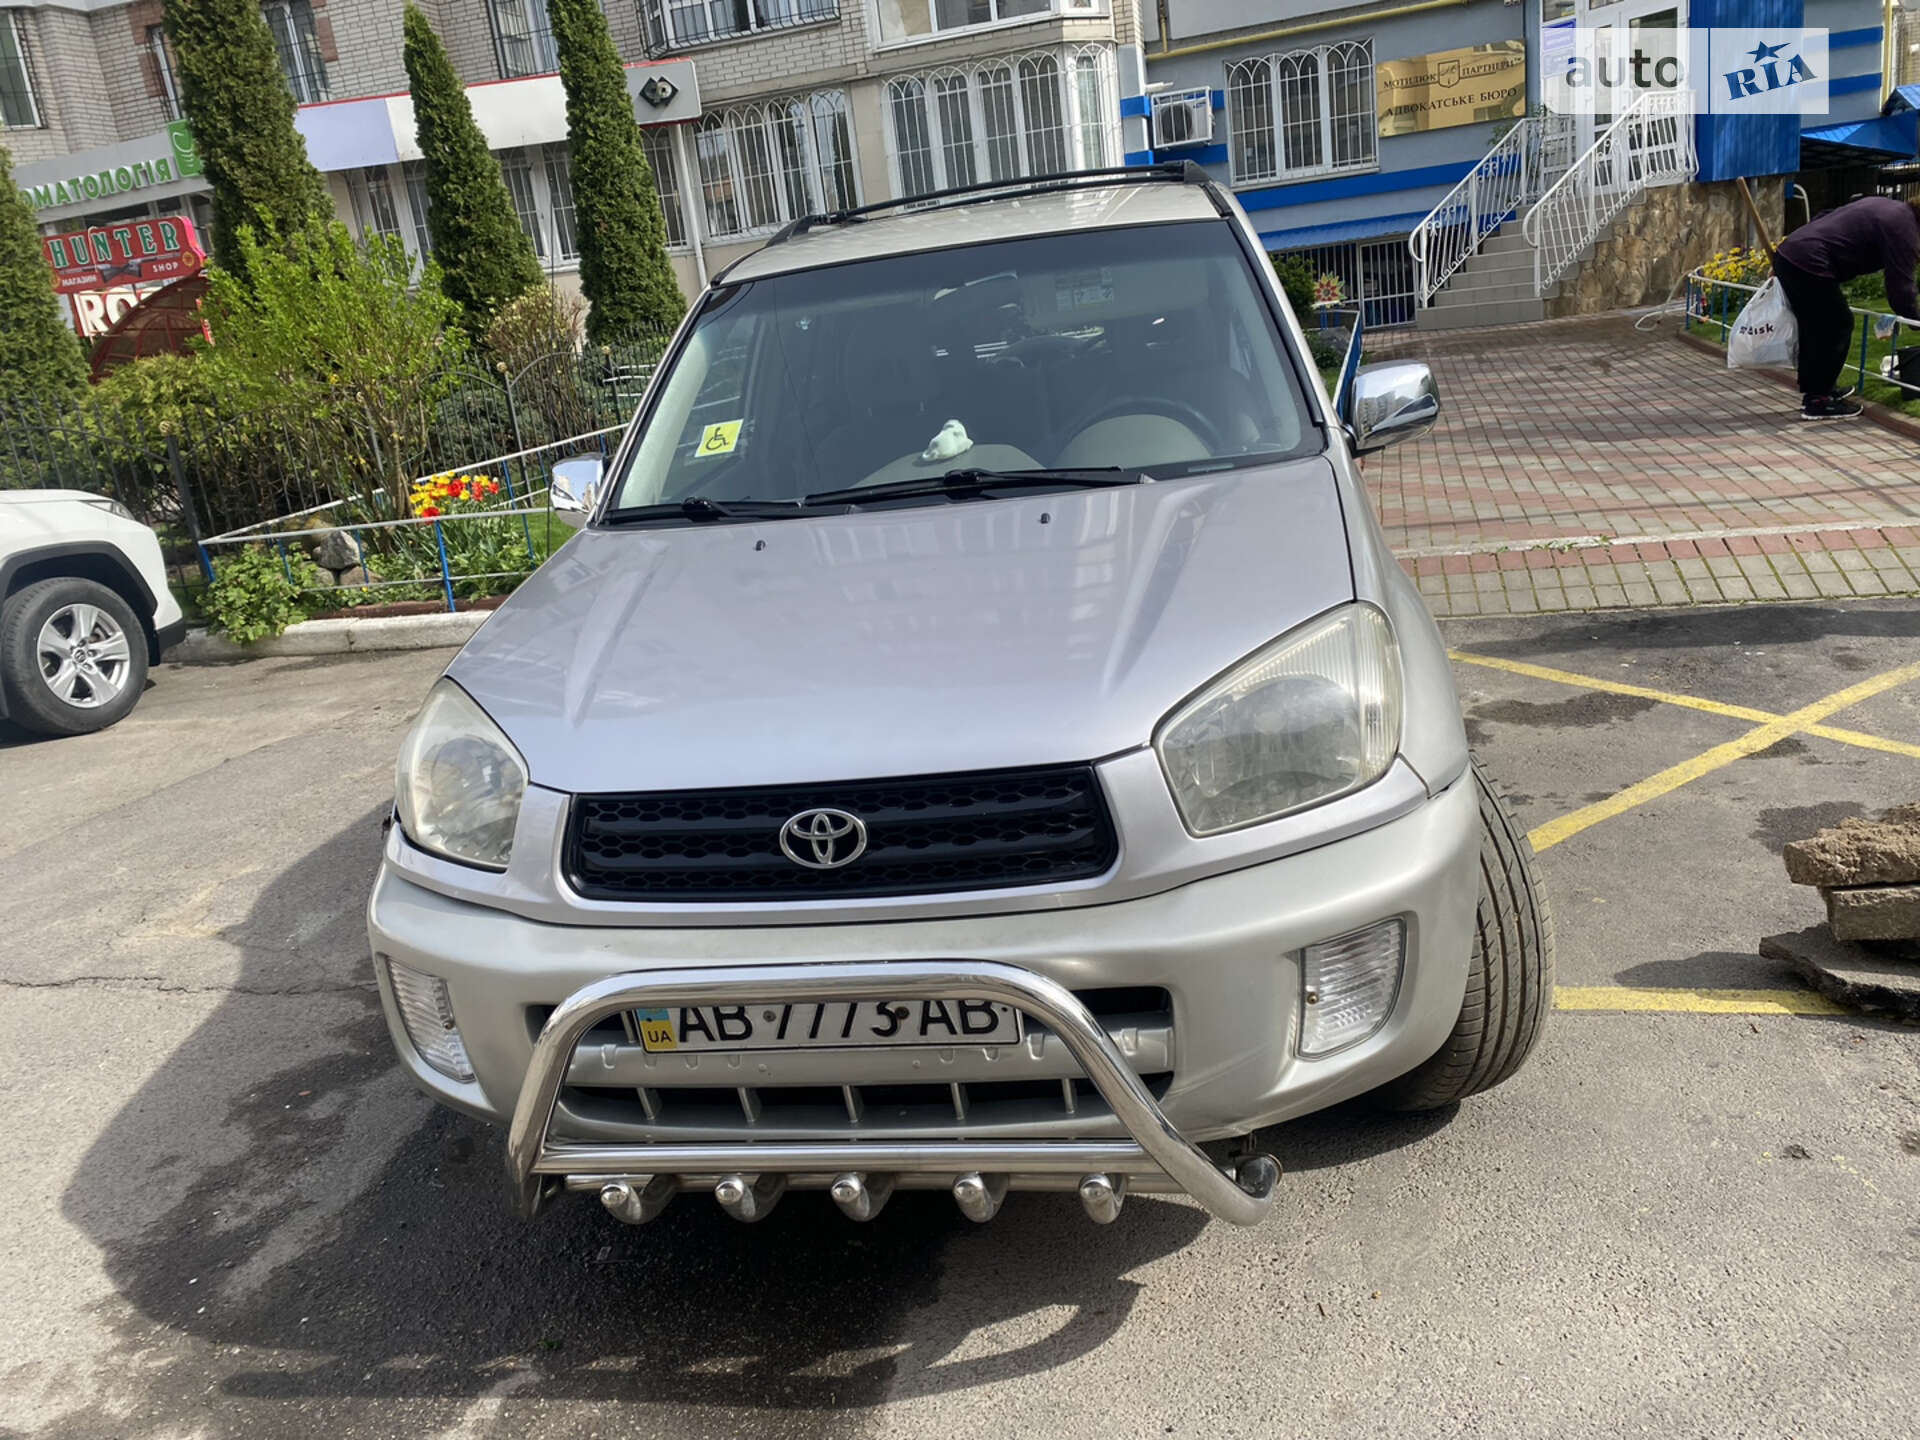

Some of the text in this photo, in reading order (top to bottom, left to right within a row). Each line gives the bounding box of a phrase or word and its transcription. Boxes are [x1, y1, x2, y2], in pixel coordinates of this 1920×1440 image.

[1385, 88, 1517, 116] АДВОКАТСЬКЕ БЮРО
[48, 222, 180, 269] HUNTER
[152, 261, 179, 273] SHOP
[679, 1005, 753, 1042] AB
[920, 1000, 999, 1036] AB
[647, 1030, 673, 1043] UA
